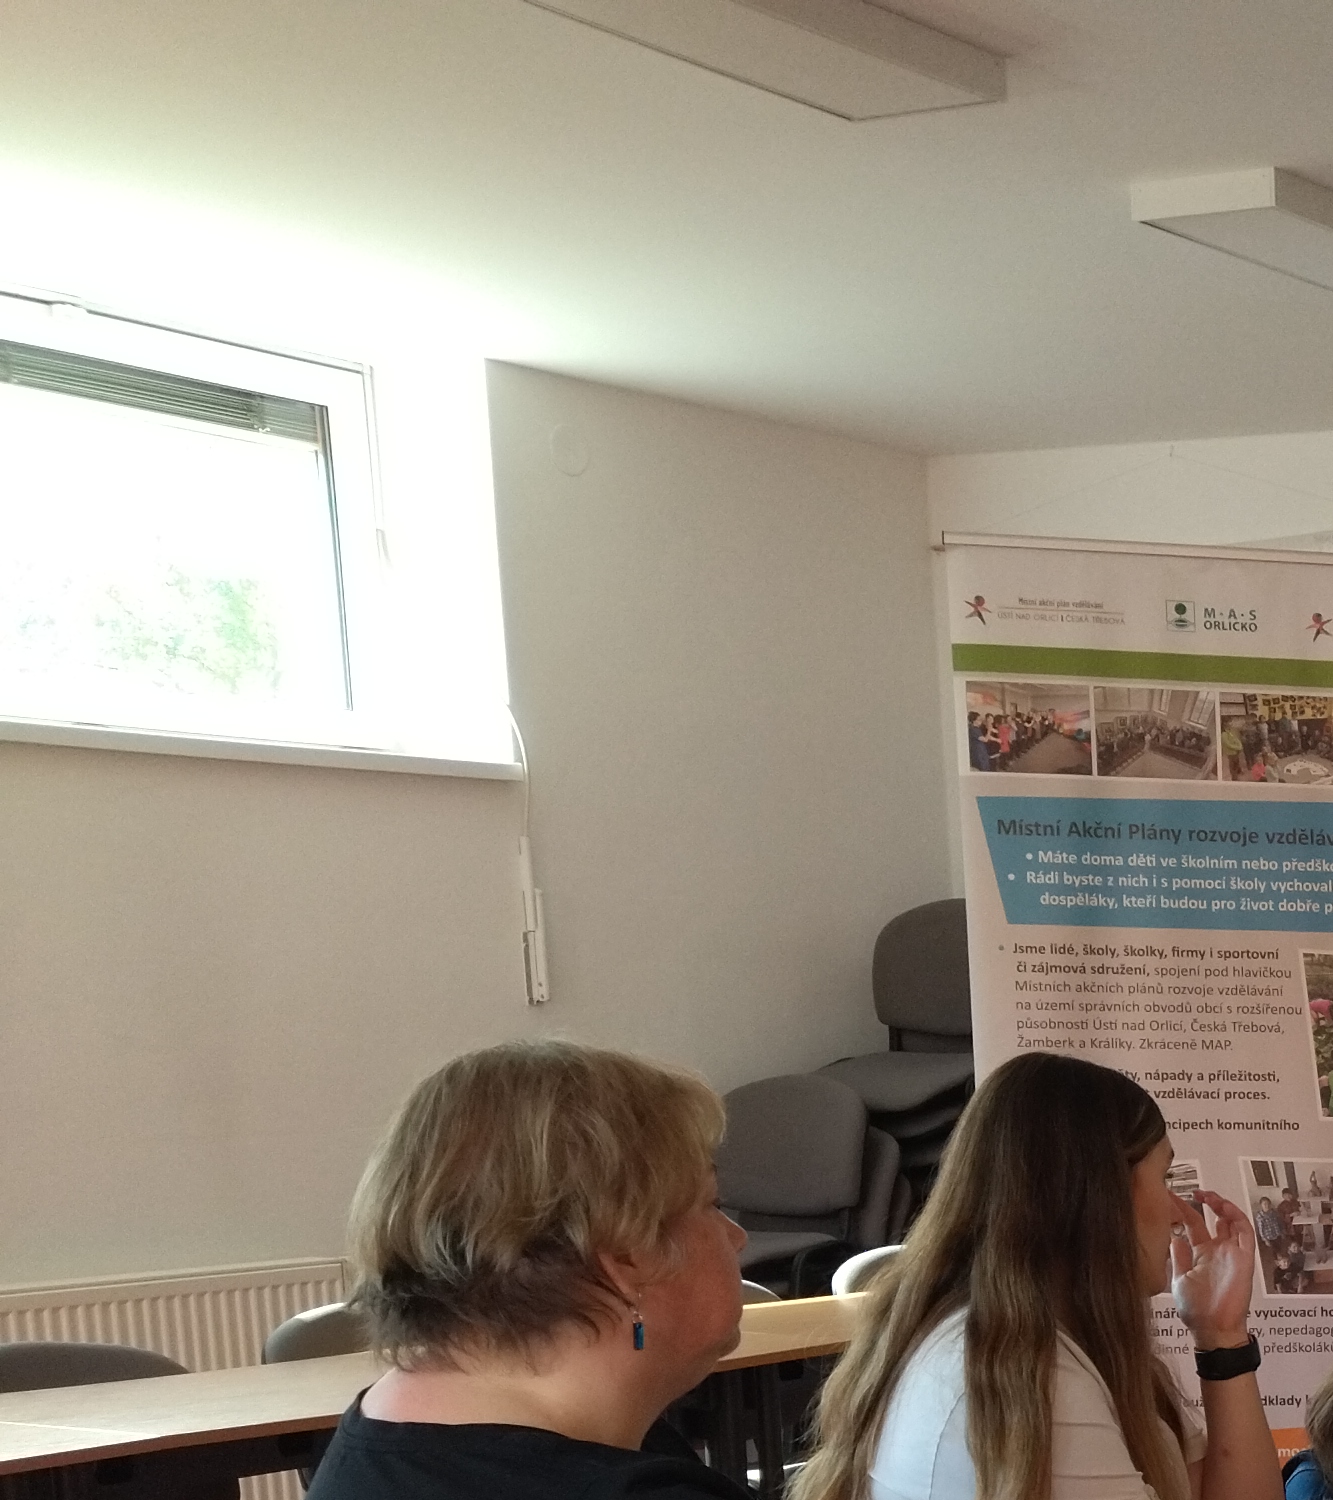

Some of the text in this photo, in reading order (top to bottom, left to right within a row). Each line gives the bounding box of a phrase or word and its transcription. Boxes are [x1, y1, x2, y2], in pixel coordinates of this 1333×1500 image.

[1203, 620, 1258, 632] ORLICKO
[997, 818, 1062, 837] Místní
[1067, 820, 1122, 839] Akční
[1128, 822, 1182, 844] Plány
[1188, 827, 1259, 847] rozvoje
[1038, 850, 1077, 865] Máte
[1081, 852, 1124, 866] doma
[1128, 853, 1156, 867] děti
[1160, 856, 1177, 868] ve
[1181, 855, 1238, 869] školním
[1242, 857, 1278, 871] nebo
[1026, 870, 1058, 885] Rádi
[1064, 872, 1103, 888] byste
[1107, 875, 1114, 886] z
[1118, 873, 1148, 887] nich
[1152, 874, 1157, 887] i
[1160, 877, 1168, 888] s
[1172, 875, 1226, 890] pomocí
[1230, 878, 1266, 893] školy
[1040, 891, 1118, 909] dospěláky,
[1122, 894, 1156, 908] kteří
[1160, 895, 1207, 910] budou
[1211, 898, 1236, 912] pro
[1240, 898, 1274, 912] život
[1278, 899, 1320, 913] dobře
[1012, 942, 1046, 955] Jsme
[1050, 943, 1079, 957] lidé,
[1082, 943, 1120, 958] školy,
[1123, 944, 1168, 960] školky,
[1171, 946, 1206, 961] firmy
[1217, 947, 1280, 963] sportovní
[1016, 960, 1292, 980] či zájmová sdružení, spojení pod hlavičkou
[1015, 980, 1284, 998] Místních akčních plánů rozvoje vzdělávání
[1016, 999, 1303, 1016] na území správních obvodů obcí s rozšířenou
[1093, 1016, 1118, 1031] Ústí
[1121, 1018, 1146, 1031] nad
[1190, 1018, 1227, 1033] Česká
[1231, 1020, 1285, 1035] Třebová,
[1017, 1034, 1233, 1052] Žamberk a Králíky. Zkráceně MAP.
[1145, 1068, 1193, 1084] nápady
[1196, 1072, 1204, 1082] a
[1208, 1069, 1280, 1084] příležitosti,
[1153, 1087, 1271, 1102] vzdělávací proces.
[1217, 1119, 1300, 1131] komunitního
[1255, 1306, 1317, 1320] vyučovací
